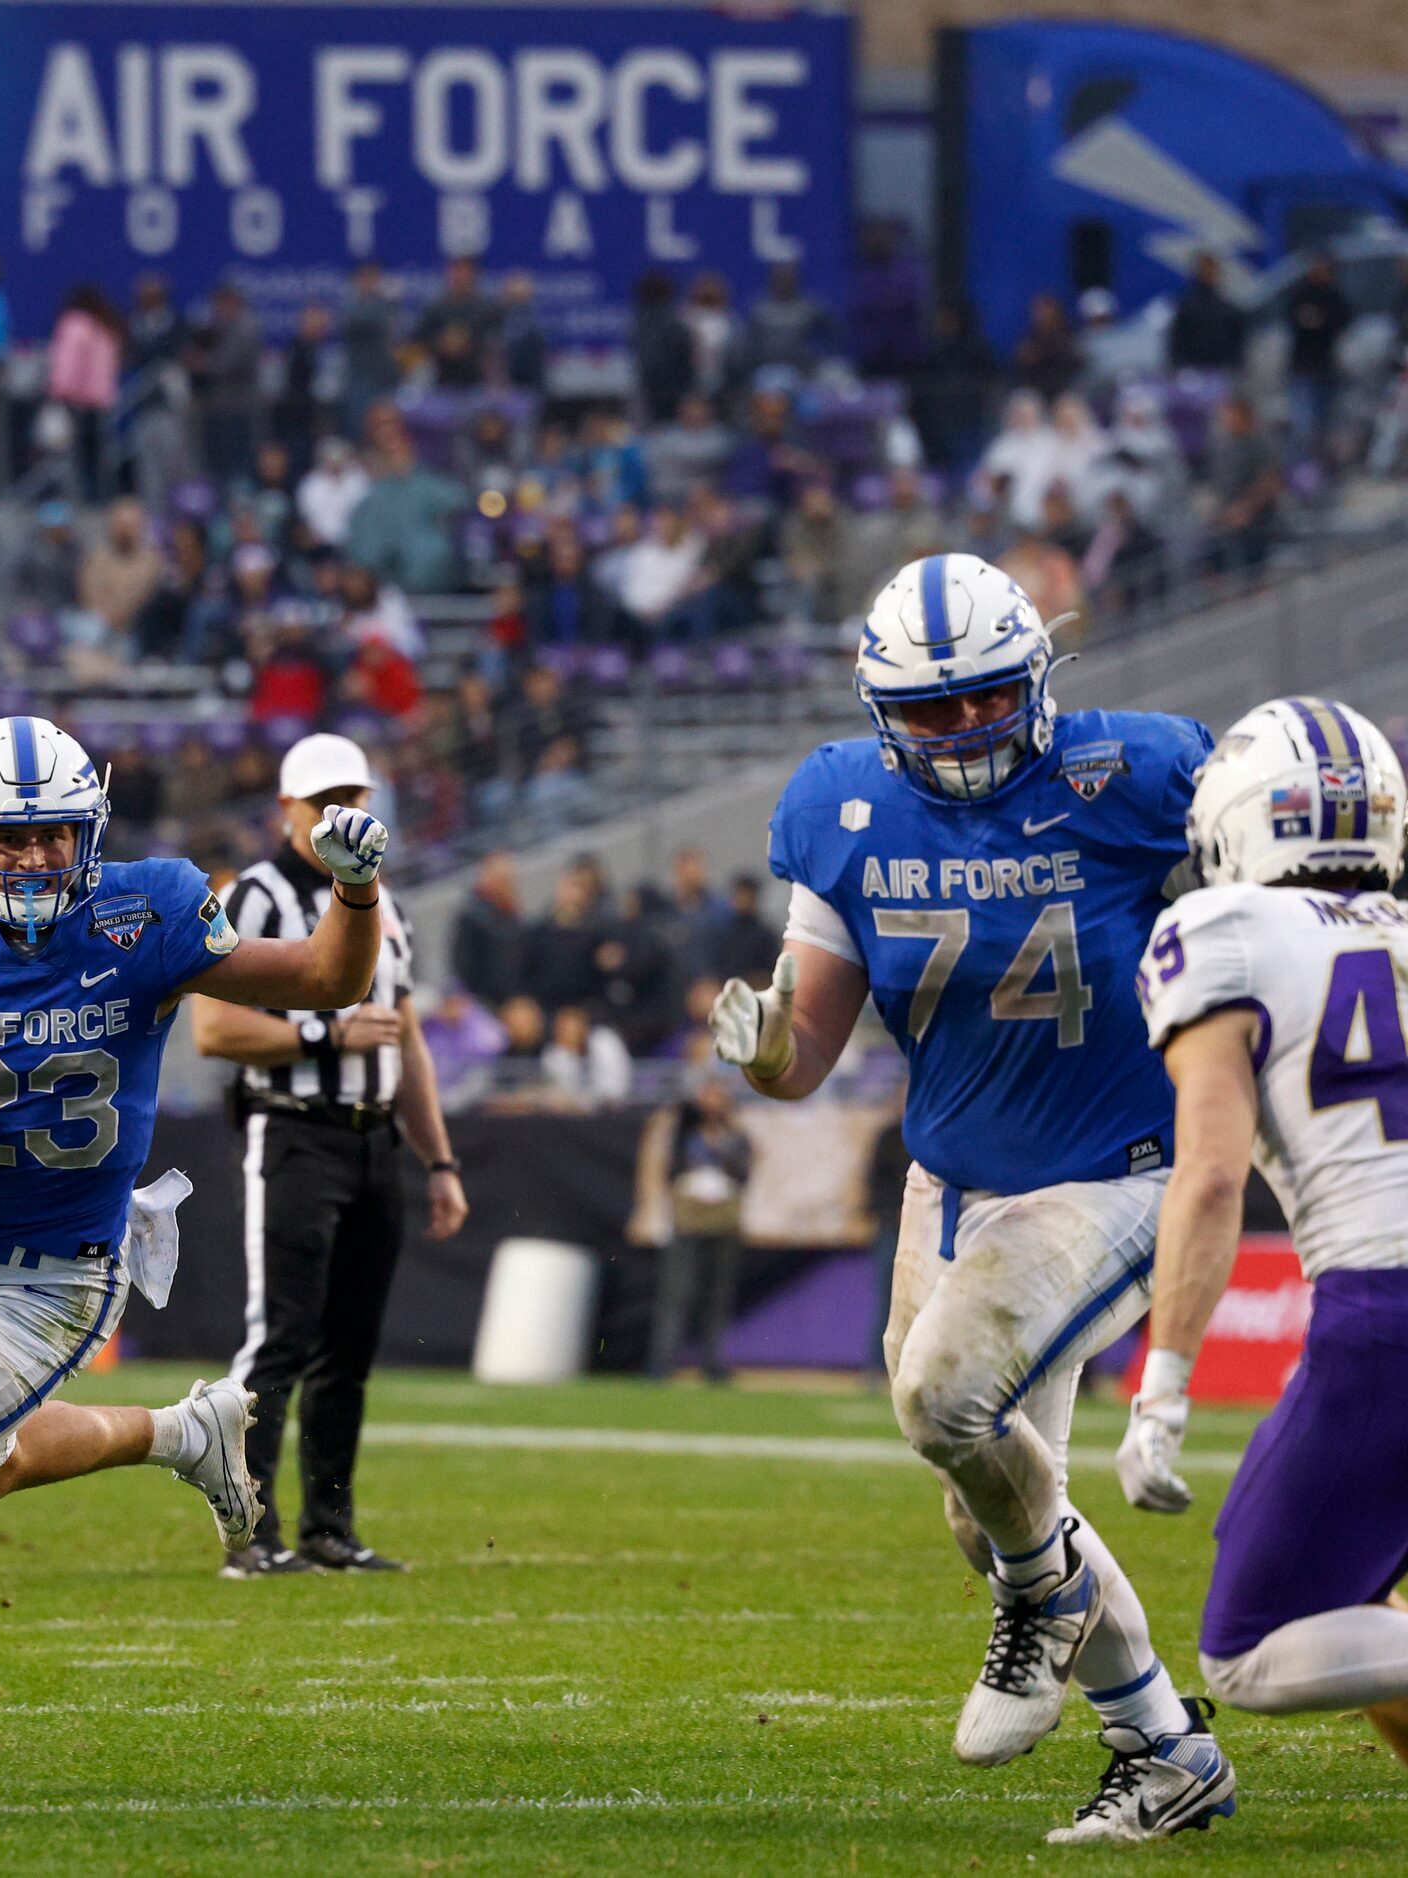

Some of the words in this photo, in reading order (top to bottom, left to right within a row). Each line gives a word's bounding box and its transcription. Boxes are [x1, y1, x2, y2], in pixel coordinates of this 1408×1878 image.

[24, 42, 255, 187] AIR
[313, 45, 810, 192] FORCE
[20, 185, 804, 262] FOOTBALL
[862, 856, 930, 900] AIR
[940, 850, 1085, 900] FORCE
[94, 917, 120, 929] ARMED
[122, 911, 152, 922] FORCES
[114, 924, 135, 932] BOWL
[872, 901, 1092, 1049] 74
[1130, 1140, 1159, 1160] 2XL
[87, 1245, 98, 1255] M
